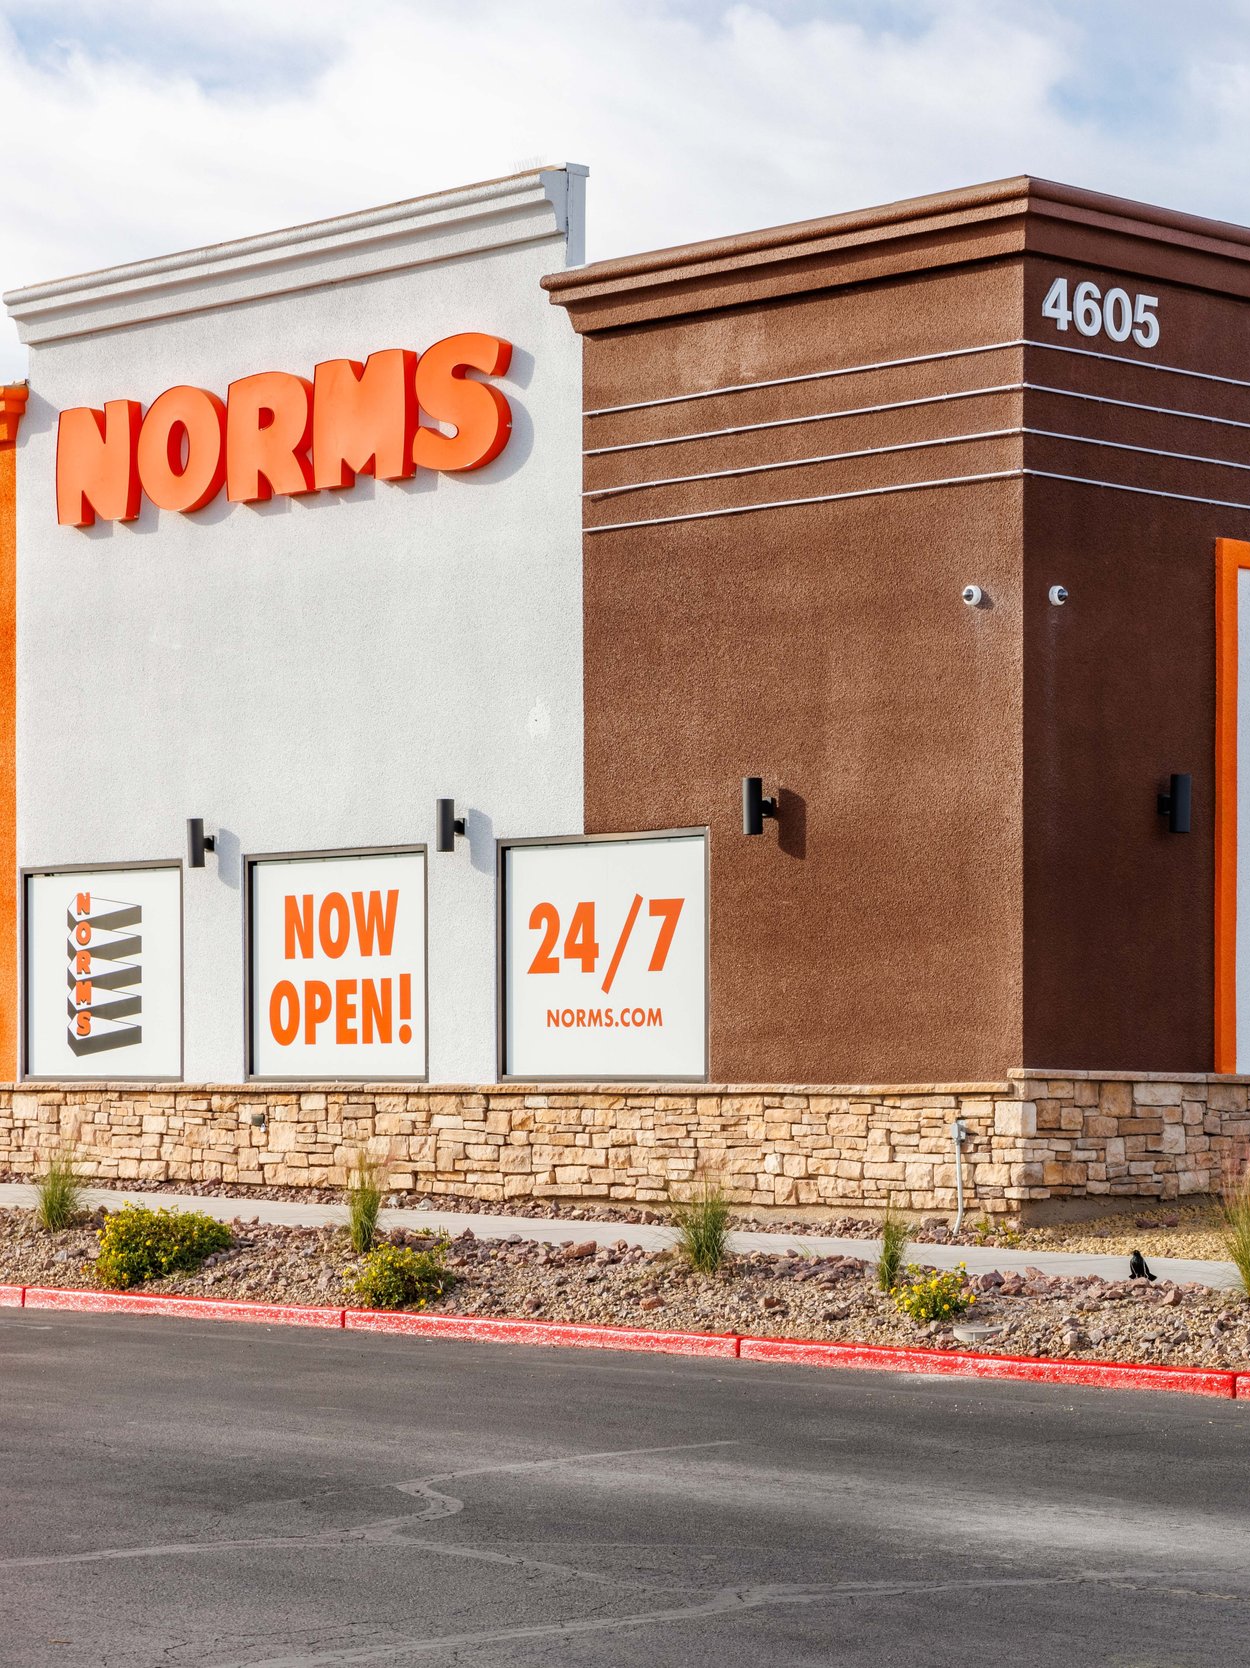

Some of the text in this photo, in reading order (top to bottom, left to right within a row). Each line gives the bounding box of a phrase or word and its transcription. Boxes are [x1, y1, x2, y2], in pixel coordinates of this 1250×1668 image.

[1042, 277, 1160, 349] 4605
[56, 332, 513, 530] NORMS
[284, 888, 400, 960] NOW
[527, 893, 685, 995] 24/7
[76, 892, 92, 1036] NORMS
[269, 973, 413, 1047] OPEN!
[546, 1007, 663, 1029] NORMS.COM
